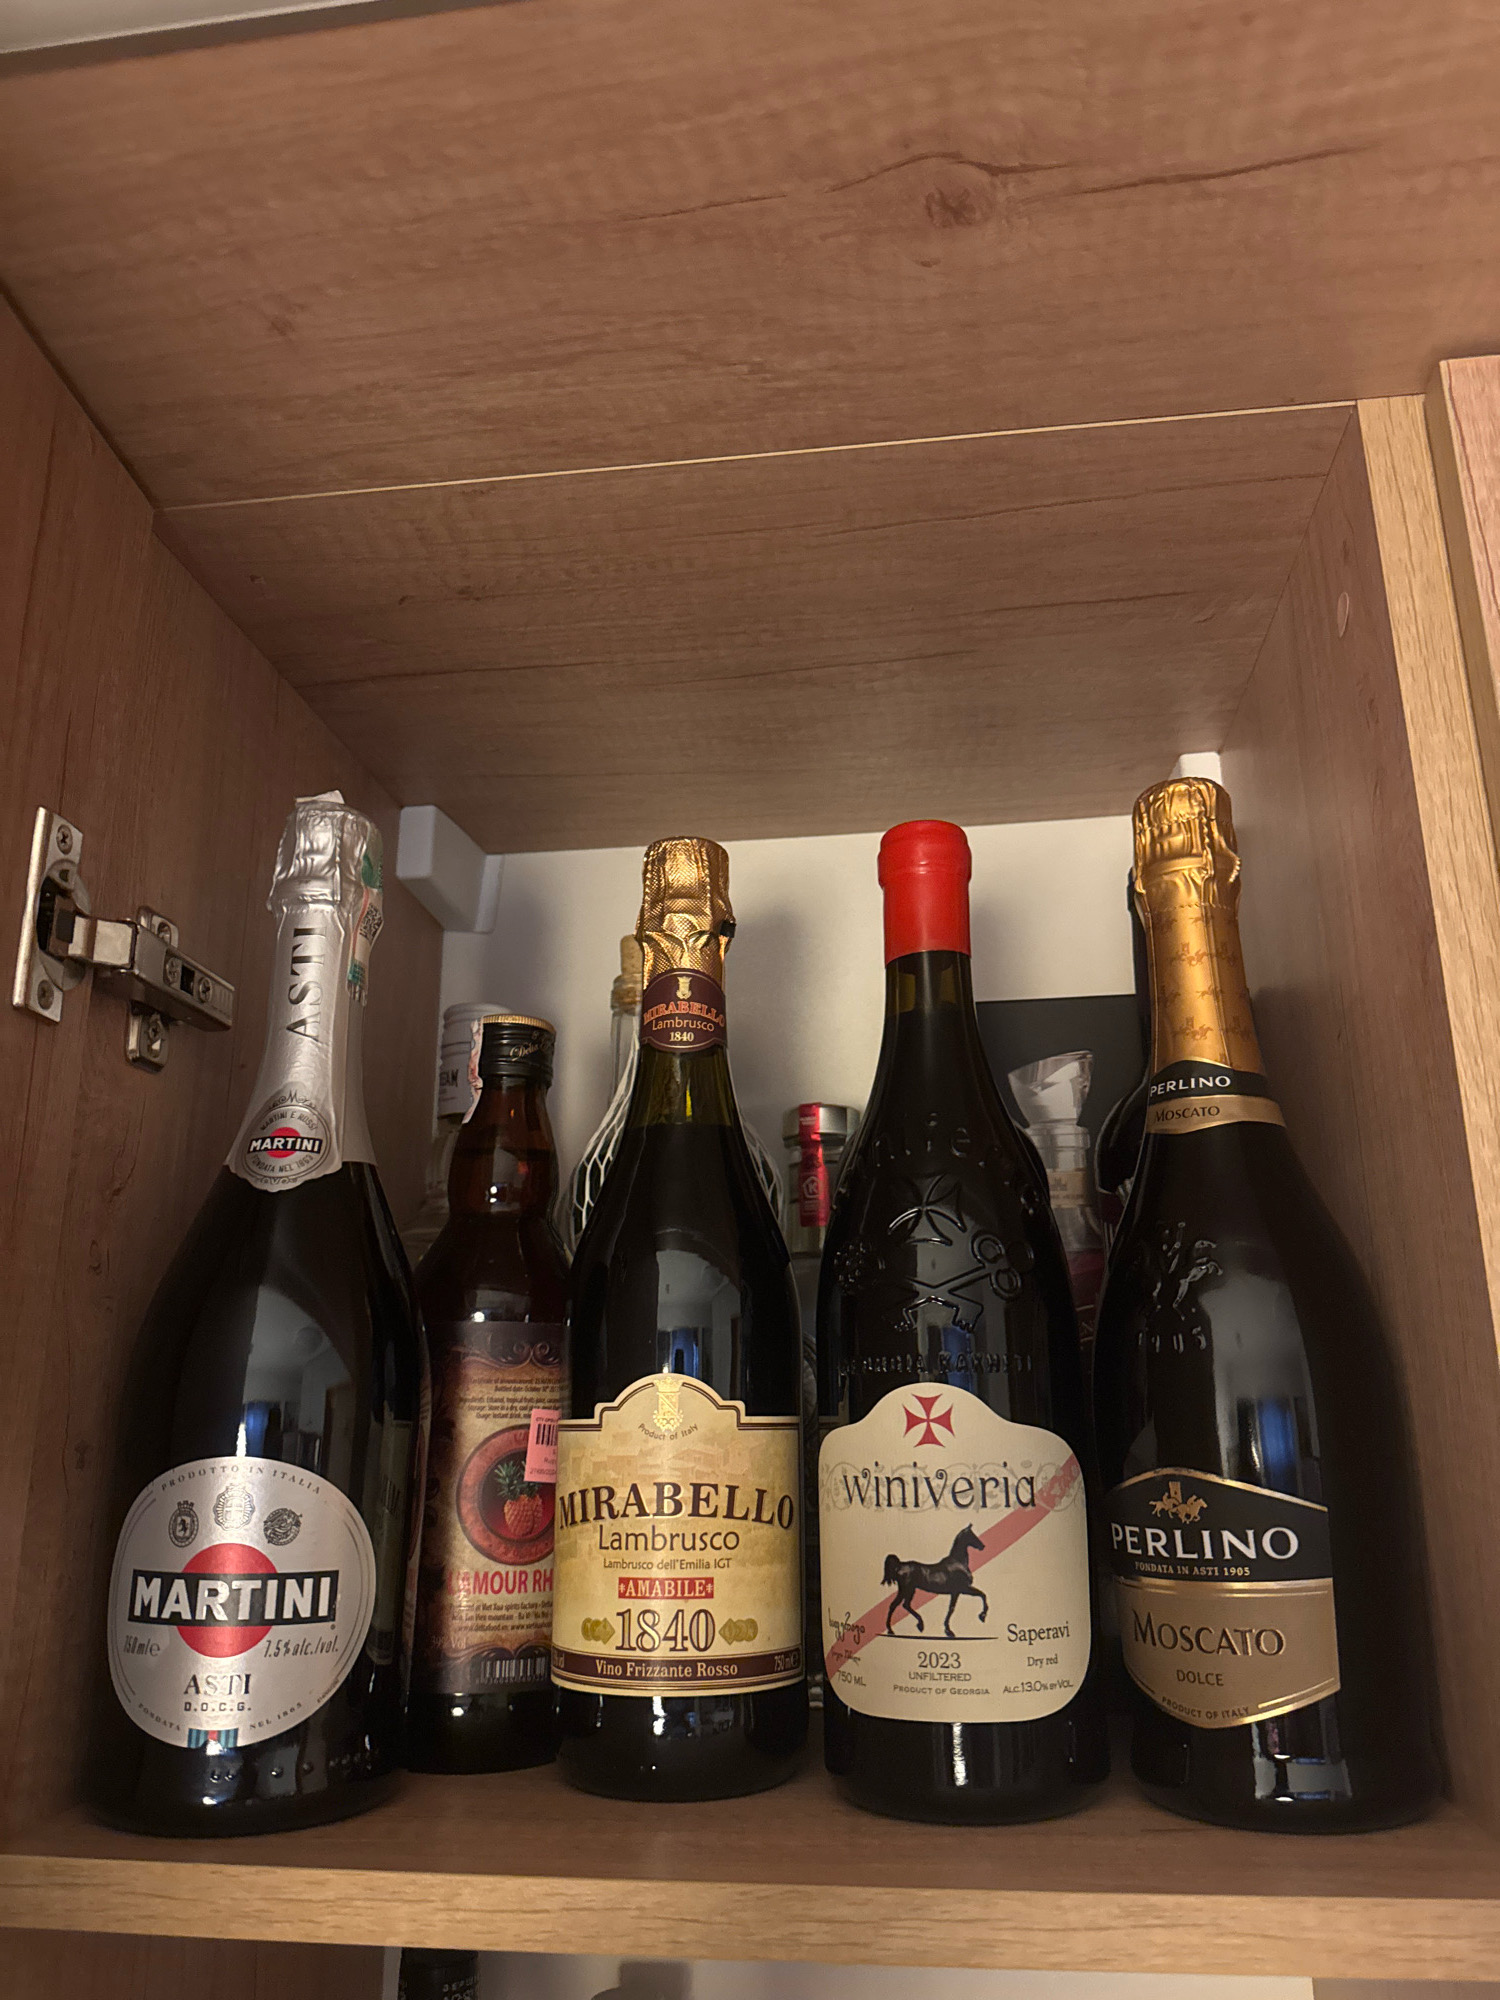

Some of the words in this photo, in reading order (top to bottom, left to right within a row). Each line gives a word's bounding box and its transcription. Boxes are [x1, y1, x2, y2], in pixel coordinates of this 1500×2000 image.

[286, 927, 328, 1043] ASTI
[643, 1001, 725, 1027] MIRABELLO
[652, 1016, 715, 1032] Lambrusco
[669, 1031, 695, 1042] 1840
[1150, 1075, 1232, 1097] PERLINO
[260, 1111, 288, 1131] MARTINI
[290, 1111, 297, 1119] E
[1154, 1105, 1221, 1122] MOSCATO
[249, 1137, 320, 1152] MARTINI
[251, 1154, 275, 1173] FONDATA
[278, 1163, 293, 1173] NEL
[638, 1422, 666, 1441] Product
[669, 1431, 679, 1441] of
[680, 1423, 699, 1440] Italy
[161, 1465, 240, 1491] PRODOTTO
[249, 1466, 264, 1474] IN
[272, 1470, 321, 1494] ITALIA
[558, 1481, 795, 1531] MIRABELLO
[598, 1524, 741, 1552] Lambrusco
[1110, 1521, 1300, 1560] PERLINO
[602, 1557, 654, 1571] Lambrusco
[656, 1557, 712, 1571] dell'Emilia
[713, 1557, 733, 1570] IGT
[1134, 1561, 1175, 1574] FONDATA
[1176, 1565, 1189, 1575] IN
[1192, 1566, 1219, 1576] ASTI
[1223, 1566, 1251, 1576] 1905
[532, 1568, 554, 1593] RH
[132, 1575, 332, 1621] MARTINI
[614, 1607, 716, 1652] 1840
[1006, 1620, 1071, 1646] Saperavi
[1132, 1608, 1286, 1657] MOSCATO
[595, 1659, 623, 1677] Vino
[626, 1662, 693, 1678] Frizzante
[696, 1661, 738, 1678] Rosso
[917, 1650, 962, 1669] 2023
[1026, 1655, 1045, 1669] Dry
[1045, 1653, 1059, 1666] red
[183, 1673, 252, 1696] ASTI
[837, 1669, 852, 1684] 750
[853, 1675, 867, 1687] ML
[908, 1671, 972, 1682] UNFILTERED
[1176, 1669, 1225, 1687] DOLCE
[893, 1684, 933, 1695] PRODUCT
[935, 1686, 947, 1695] OF
[949, 1686, 991, 1696] GEORGIA
[184, 1701, 253, 1712] D.O.C.G.
[1161, 1695, 1202, 1719] PRODUCT
[1205, 1710, 1219, 1720] OF
[1220, 1706, 1250, 1719] ITALY
[138, 1702, 181, 1732] FONDATA
[250, 1717, 272, 1730] NEL
